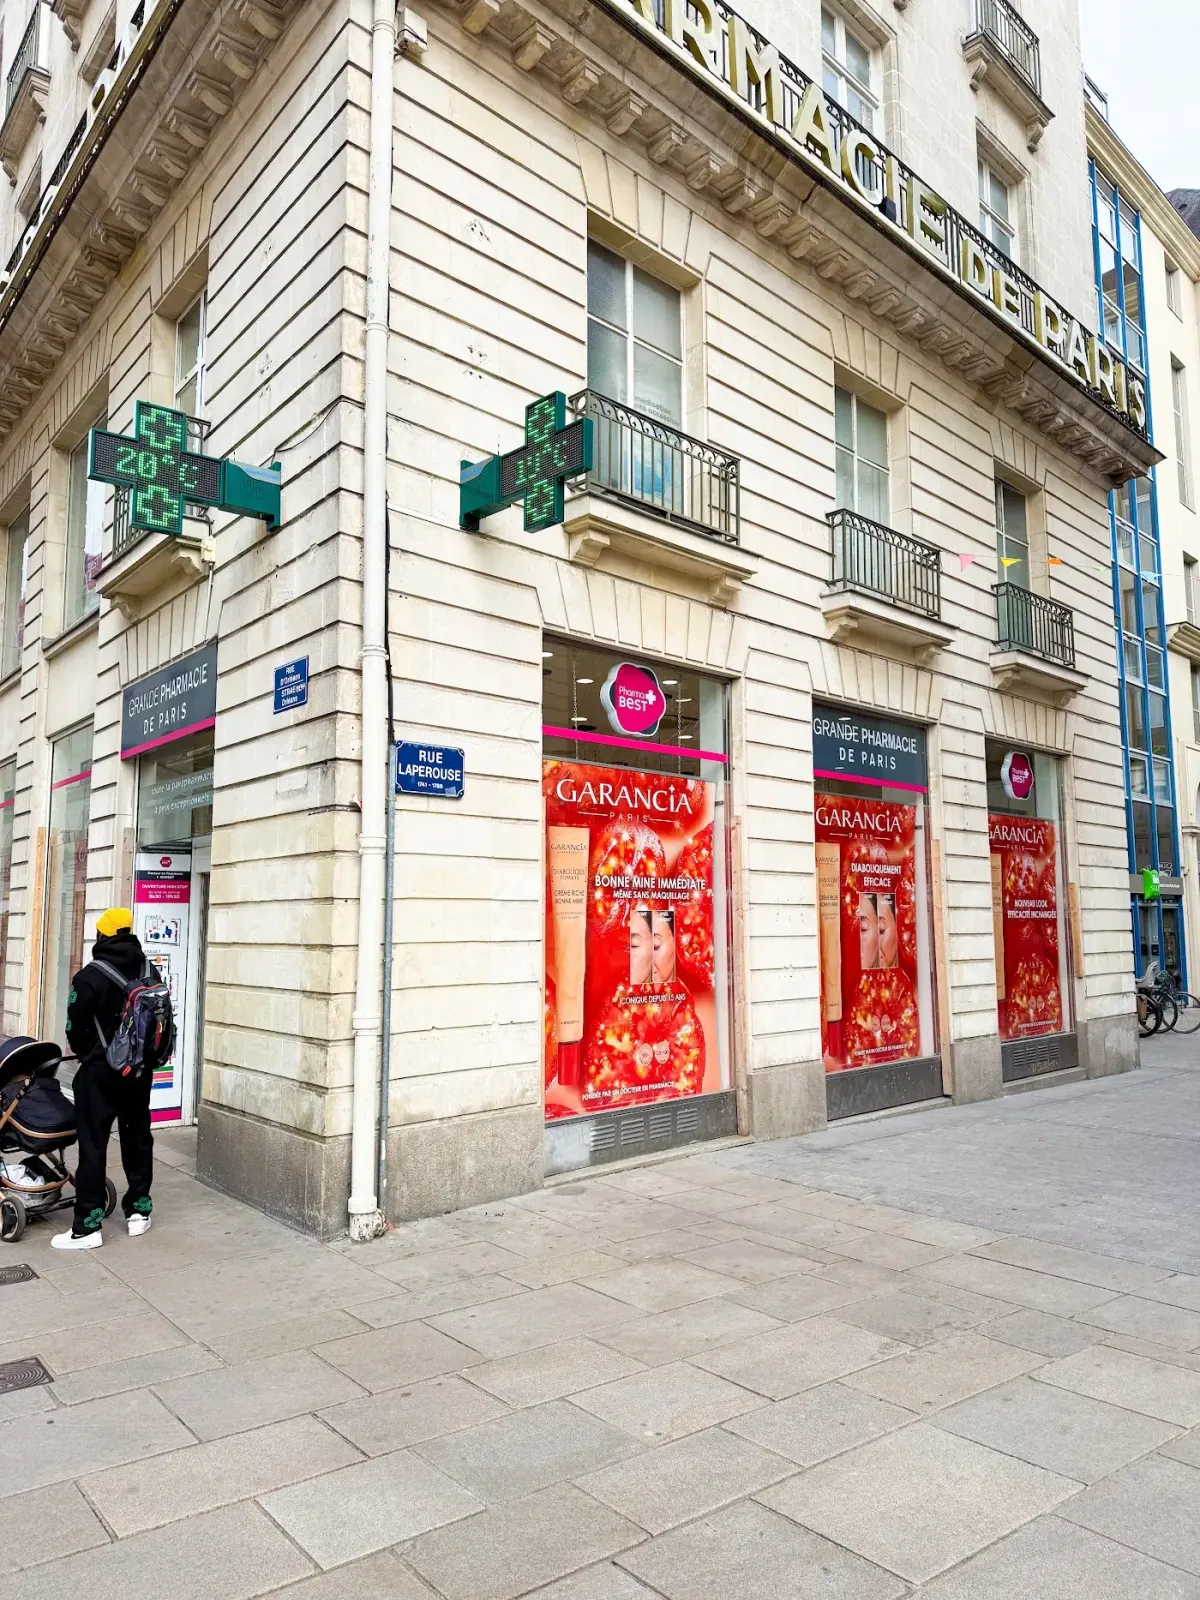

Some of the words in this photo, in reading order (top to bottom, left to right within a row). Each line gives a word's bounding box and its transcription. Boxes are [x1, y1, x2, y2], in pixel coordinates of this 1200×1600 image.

[632, 0, 949, 268] RMACIE
[962, 238, 1021, 325] DE
[1034, 290, 1146, 430] PARIS
[128, 687, 159, 718] GRANDE
[160, 663, 208, 703] PHARMACIE
[618, 685, 645, 699] Pharma
[143, 716, 155, 735] DE
[158, 702, 187, 728] PARIS
[813, 717, 859, 743] GRANDE
[861, 728, 918, 754] PHARMACIE
[419, 749, 443, 764] RUE
[839, 747, 855, 763] DE
[861, 751, 896, 770] PARIS
[398, 762, 461, 781] LAPEROUSE
[609, 812, 648, 823] PARIS
[848, 832, 874, 841] PARIS
[595, 874, 630, 888] BONNE
[632, 876, 656, 889] MINE
[863, 876, 892, 887] EFFICACE
[633, 890, 650, 899] SANS
[651, 891, 690, 900] MAQUILLAGE
[648, 994, 667, 1003] DEPUIS
[675, 993, 686, 1001] ANS
[619, 1086, 642, 1096] DOCTEUR
[649, 1081, 675, 1092] PHARMACIE
